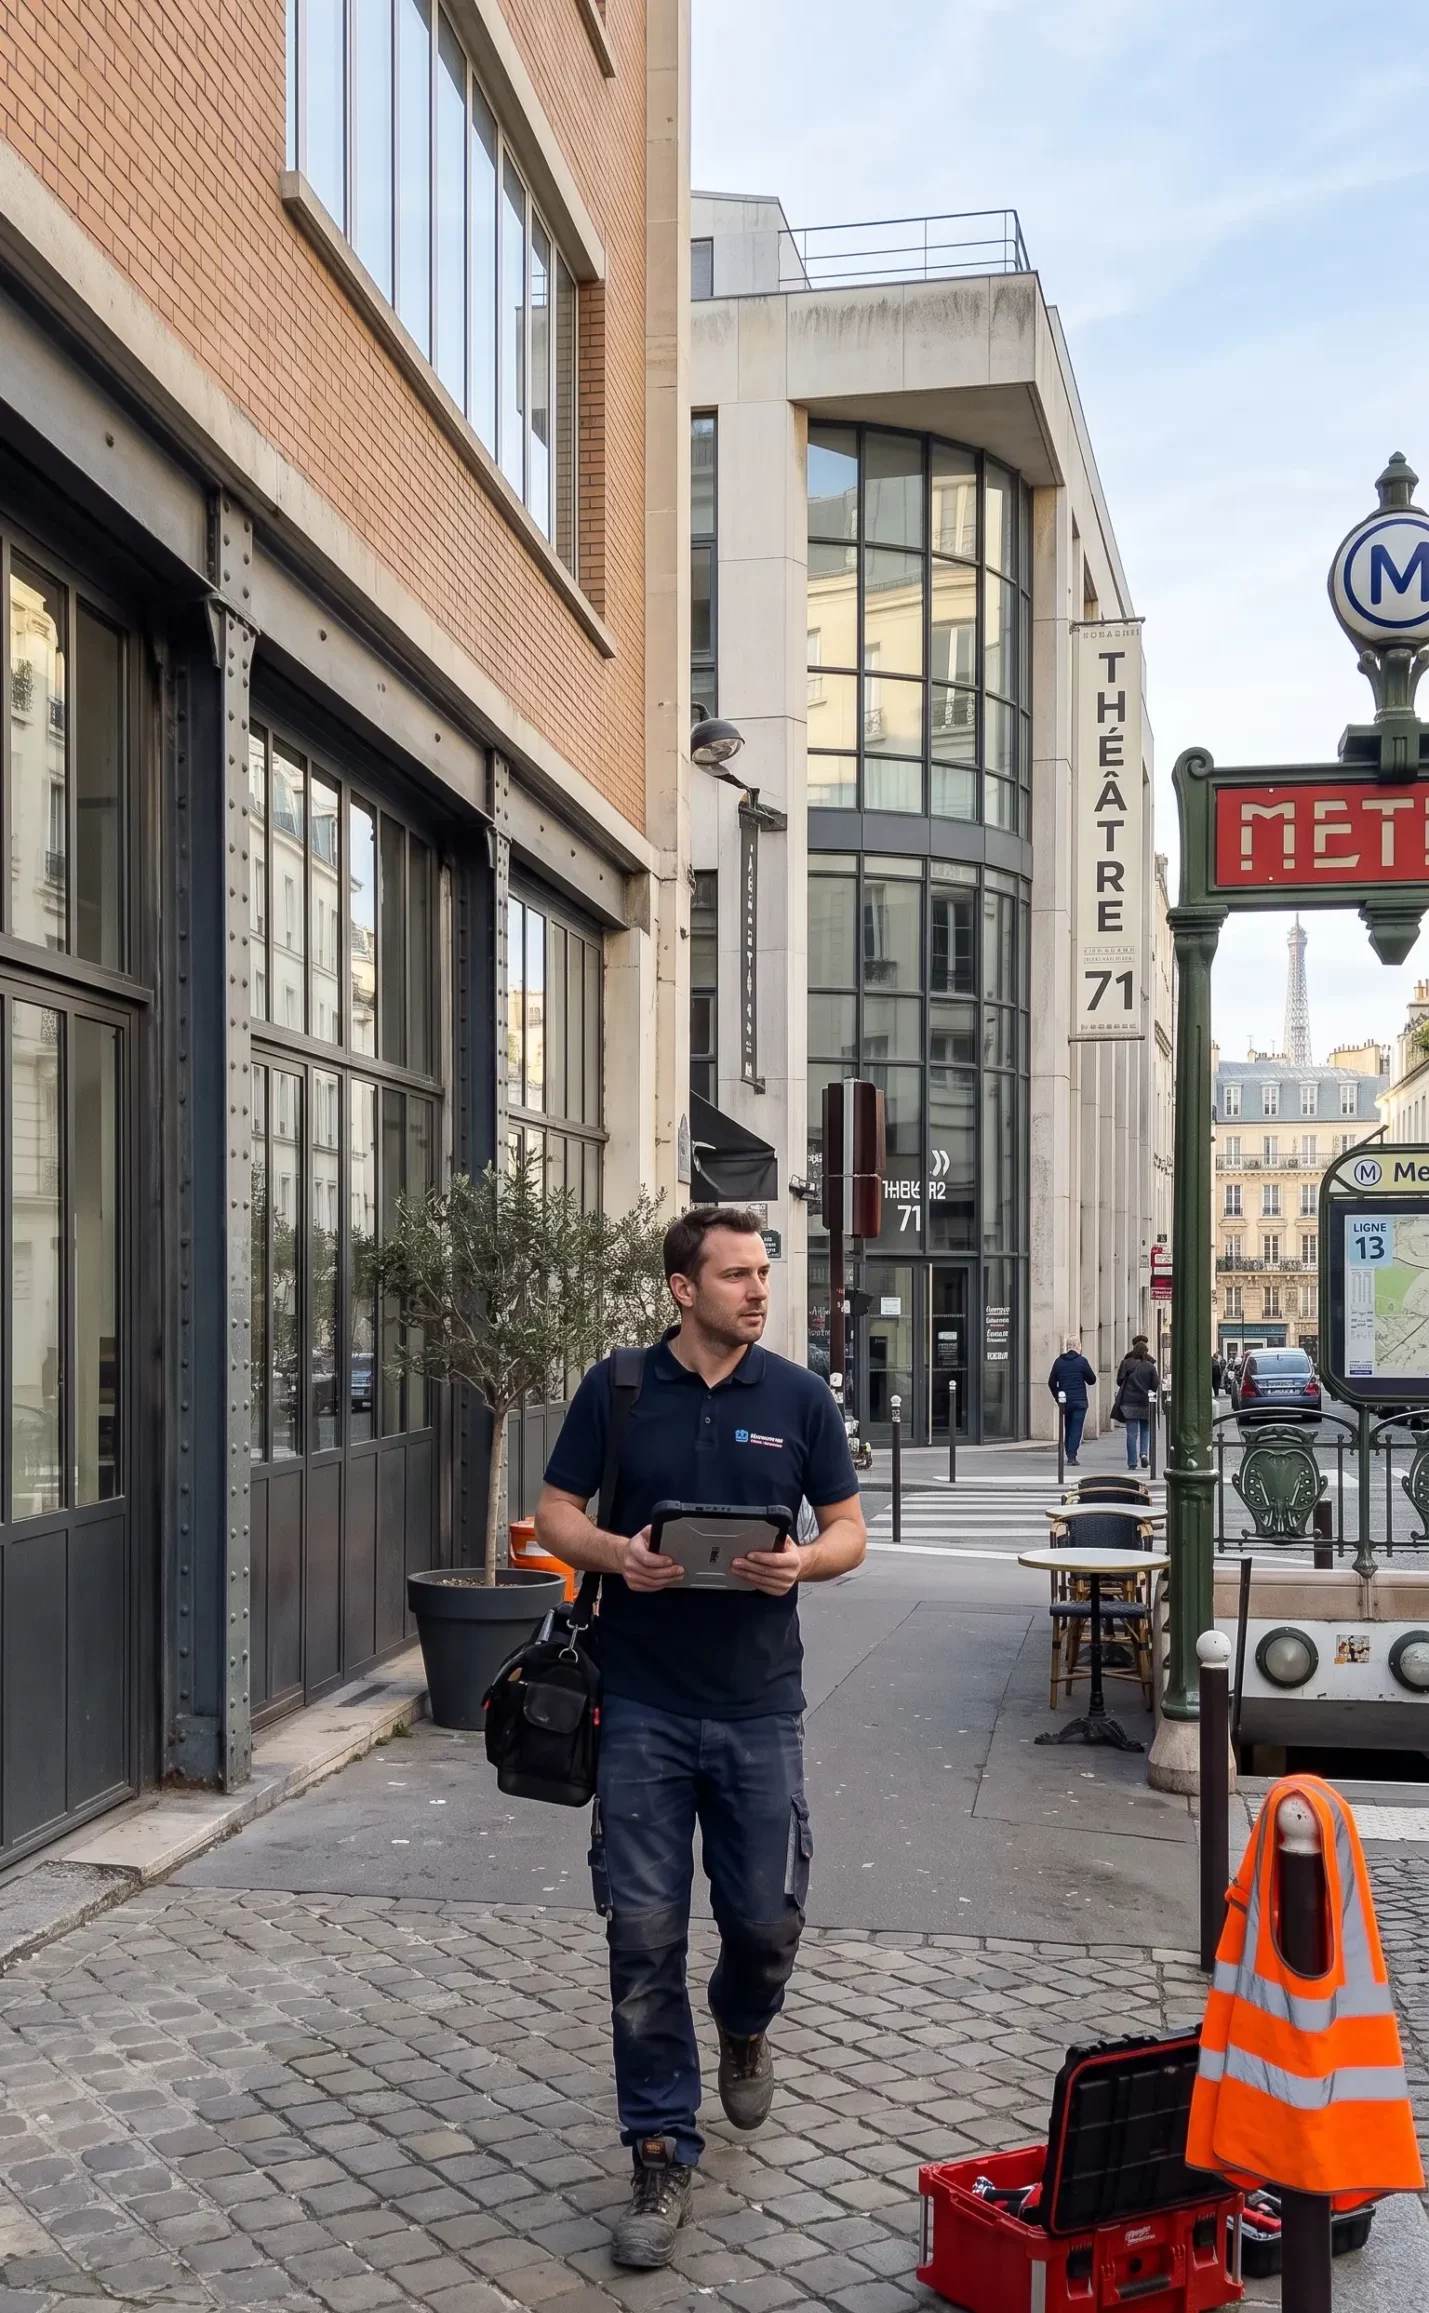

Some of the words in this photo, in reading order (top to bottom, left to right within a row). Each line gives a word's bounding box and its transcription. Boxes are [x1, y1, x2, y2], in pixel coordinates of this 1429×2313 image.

[1371, 541, 1429, 605] M
[1094, 652, 1128, 932] THÉÂTRE
[1240, 798, 1429, 870] MET
[1085, 970, 1133, 1011] 71
[1394, 1162, 1429, 1182] Me
[897, 1205, 920, 1231] 71
[1353, 1223, 1387, 1232] LIGNE
[1355, 1236, 1385, 1259] 13
